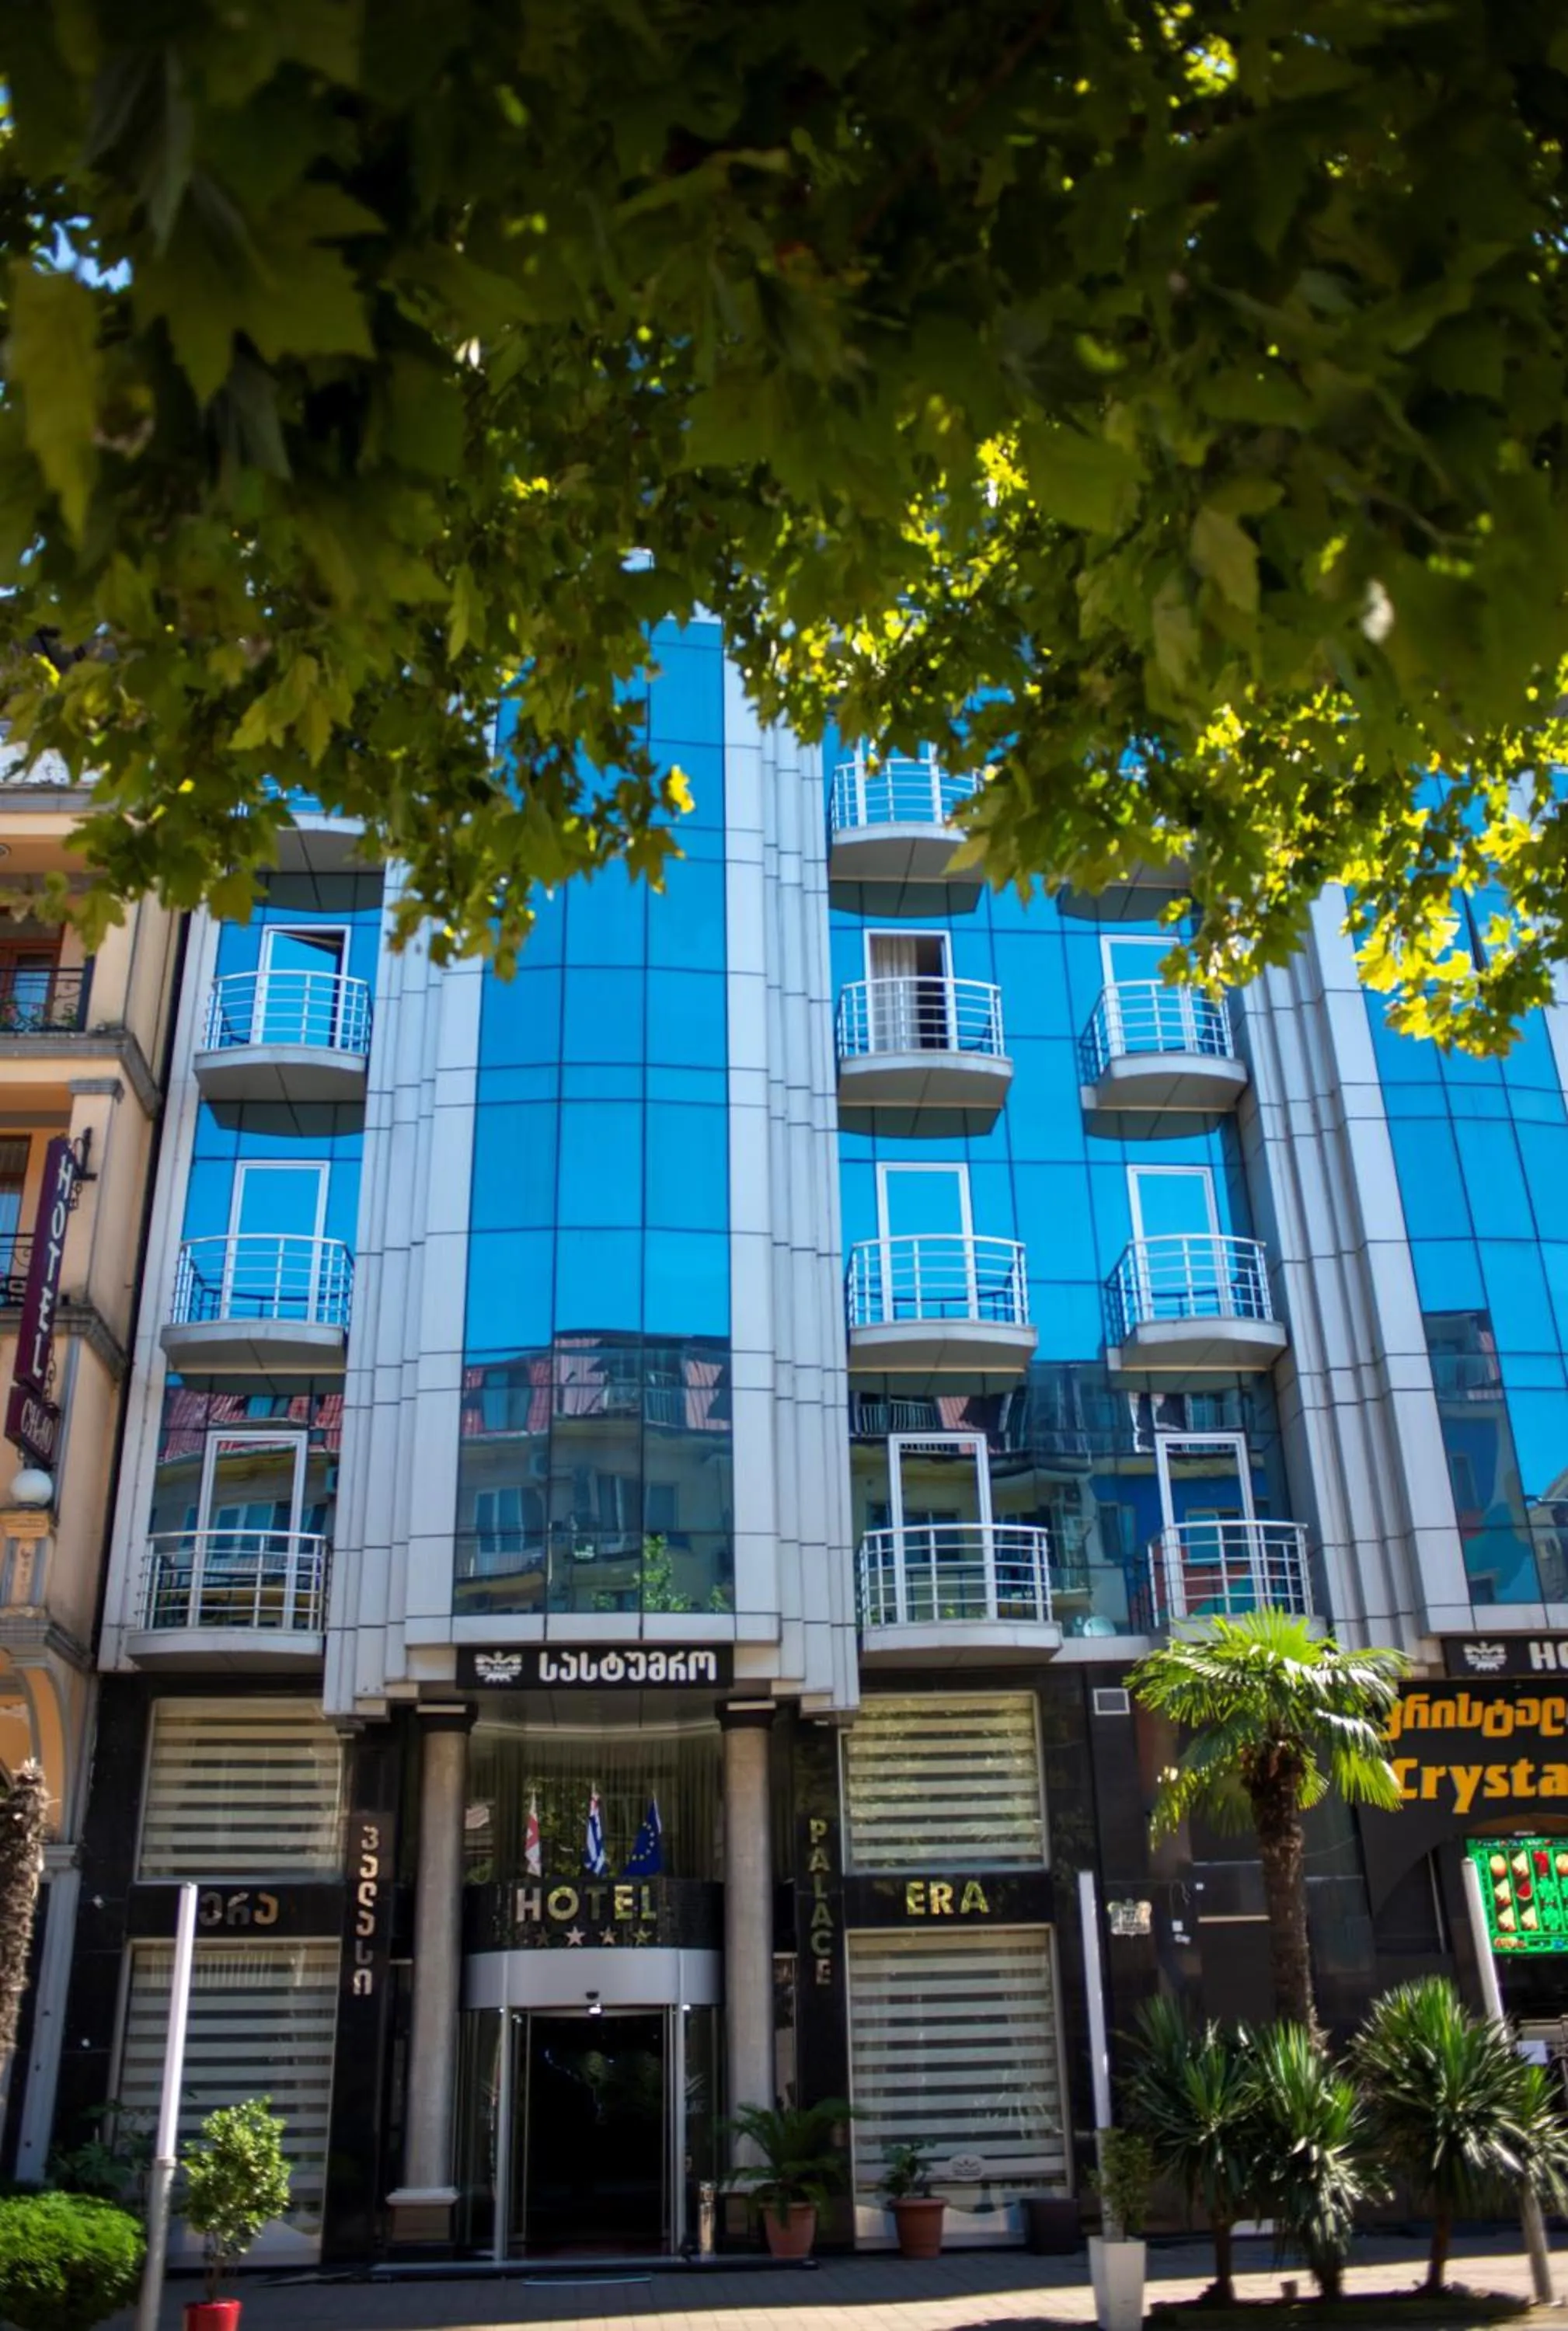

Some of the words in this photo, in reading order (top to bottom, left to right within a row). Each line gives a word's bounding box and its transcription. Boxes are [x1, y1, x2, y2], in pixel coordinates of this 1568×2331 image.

[32, 1153, 72, 1378] HOTEL
[538, 1650, 717, 1682] სასტუმრო
[1389, 1758, 1568, 1814] Crysta
[199, 1891, 278, 1926] ერა
[353, 1825, 379, 1996] პალასი
[516, 1884, 657, 1922] HOTEL
[808, 1817, 834, 1984] PALACE
[905, 1880, 991, 1915] ERA
